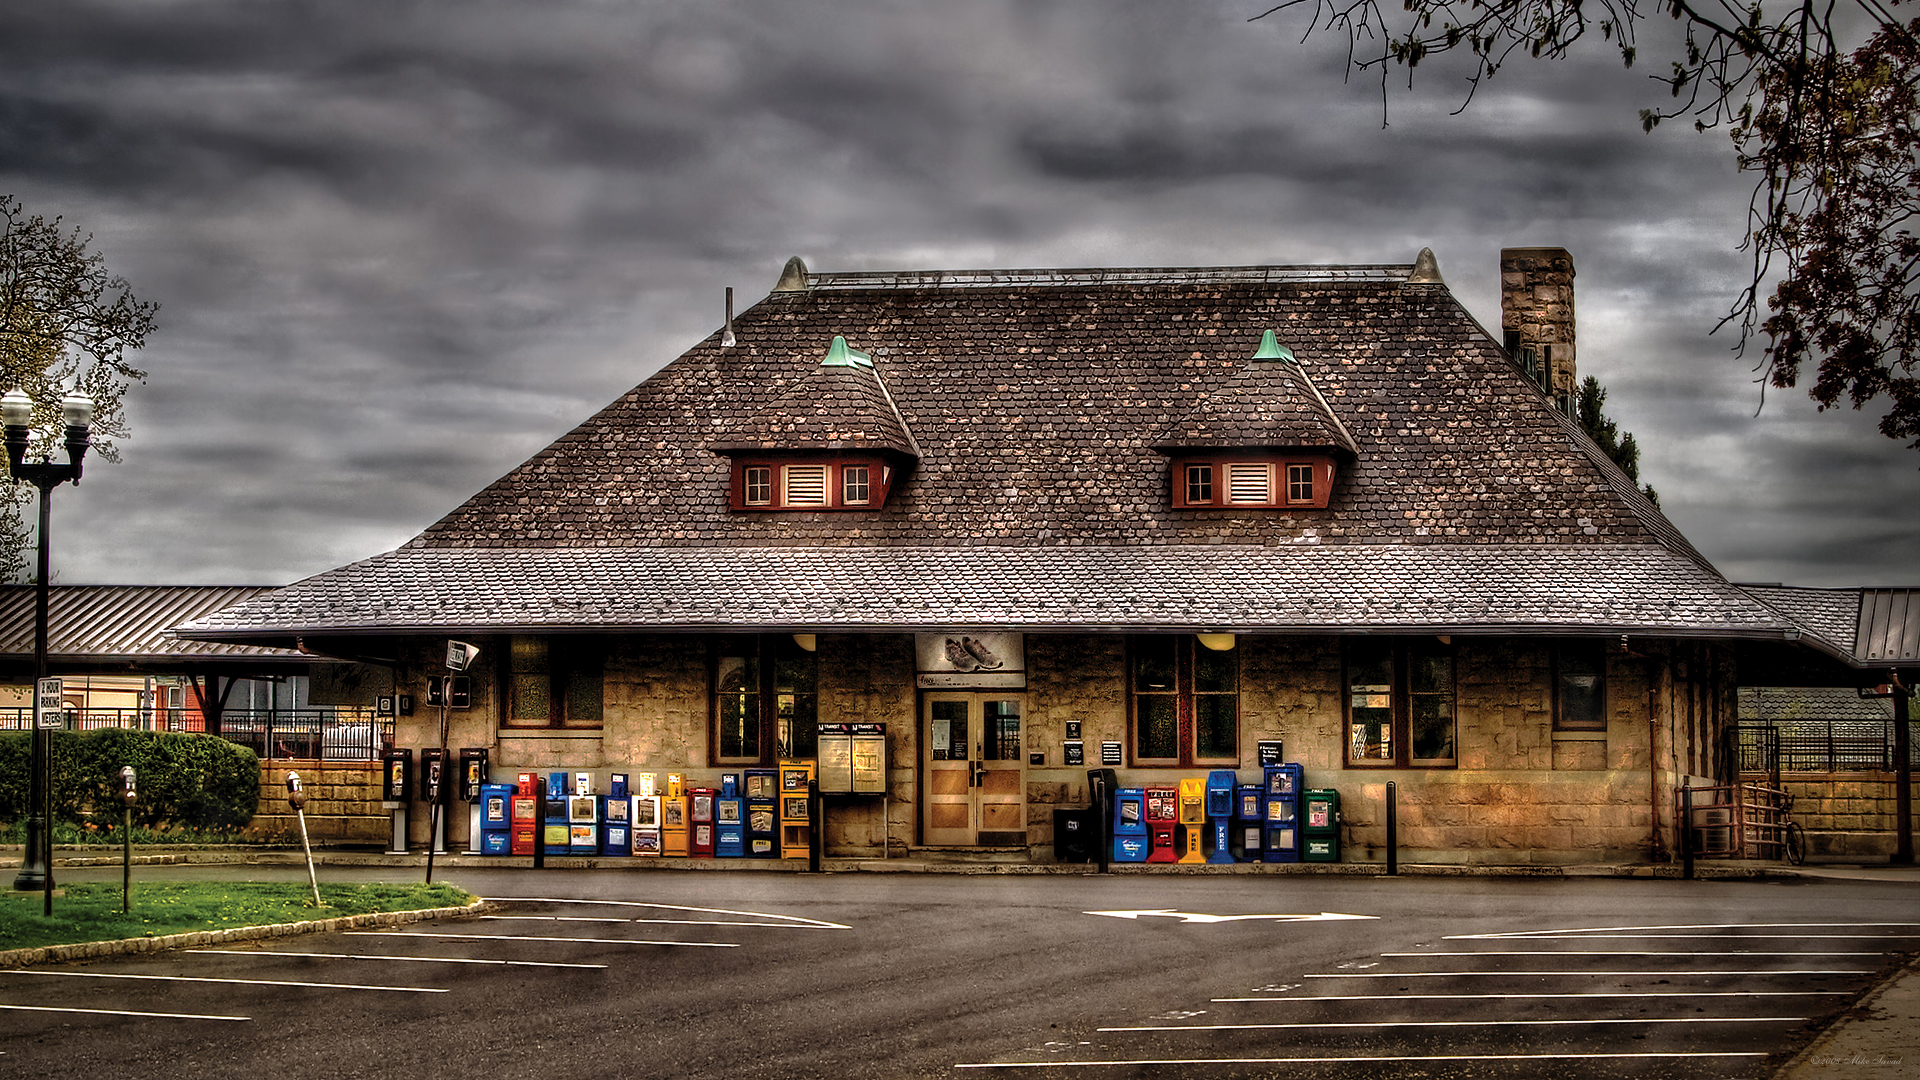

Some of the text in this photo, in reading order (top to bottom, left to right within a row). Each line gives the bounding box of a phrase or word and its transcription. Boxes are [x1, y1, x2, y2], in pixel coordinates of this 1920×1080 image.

[46, 682, 60, 693] HOUR
[41, 697, 60, 708] PARKING
[42, 712, 60, 725] METERS
